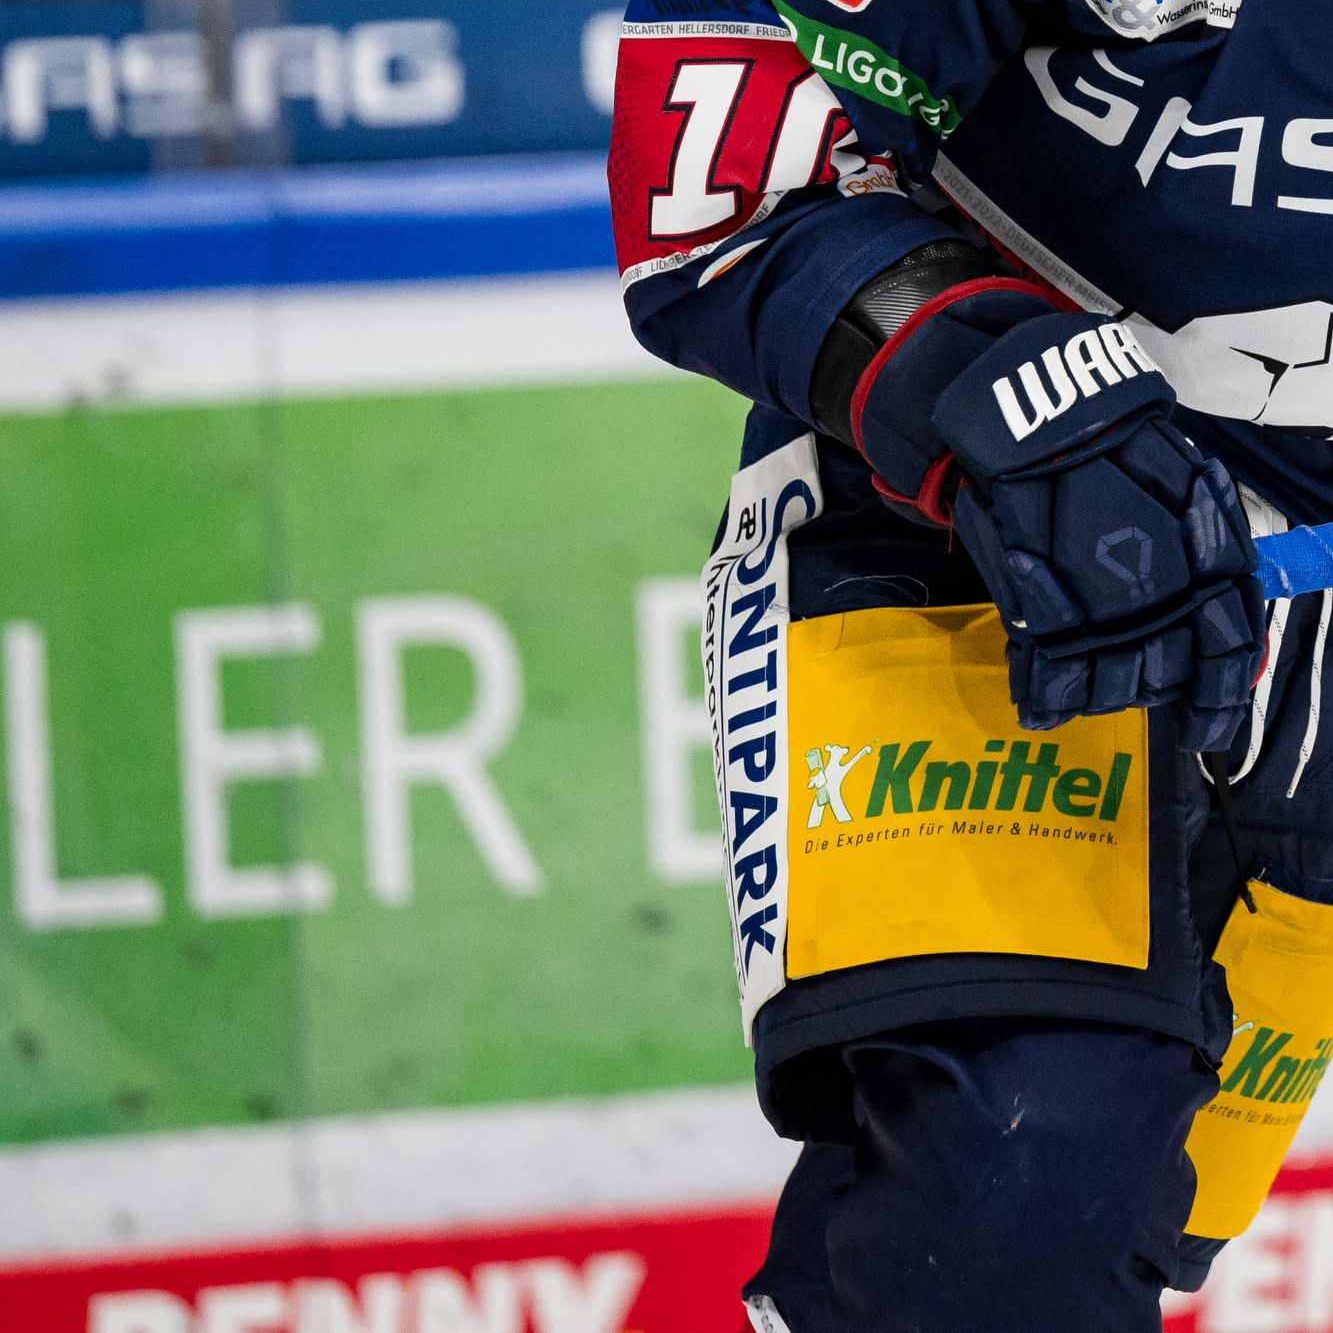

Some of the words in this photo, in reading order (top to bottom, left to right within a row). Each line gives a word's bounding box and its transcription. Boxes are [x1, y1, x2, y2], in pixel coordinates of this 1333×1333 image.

[678, 23, 750, 36] HELLERSDORF
[3, 590, 546, 932] LER
[865, 739, 1133, 822] Knittel
[804, 839, 829, 855] Die
[836, 824, 910, 849] Experten
[918, 822, 943, 837] für
[951, 821, 1004, 836] Maler
[1010, 822, 1022, 836] &
[1029, 823, 1119, 846] Handwerk.
